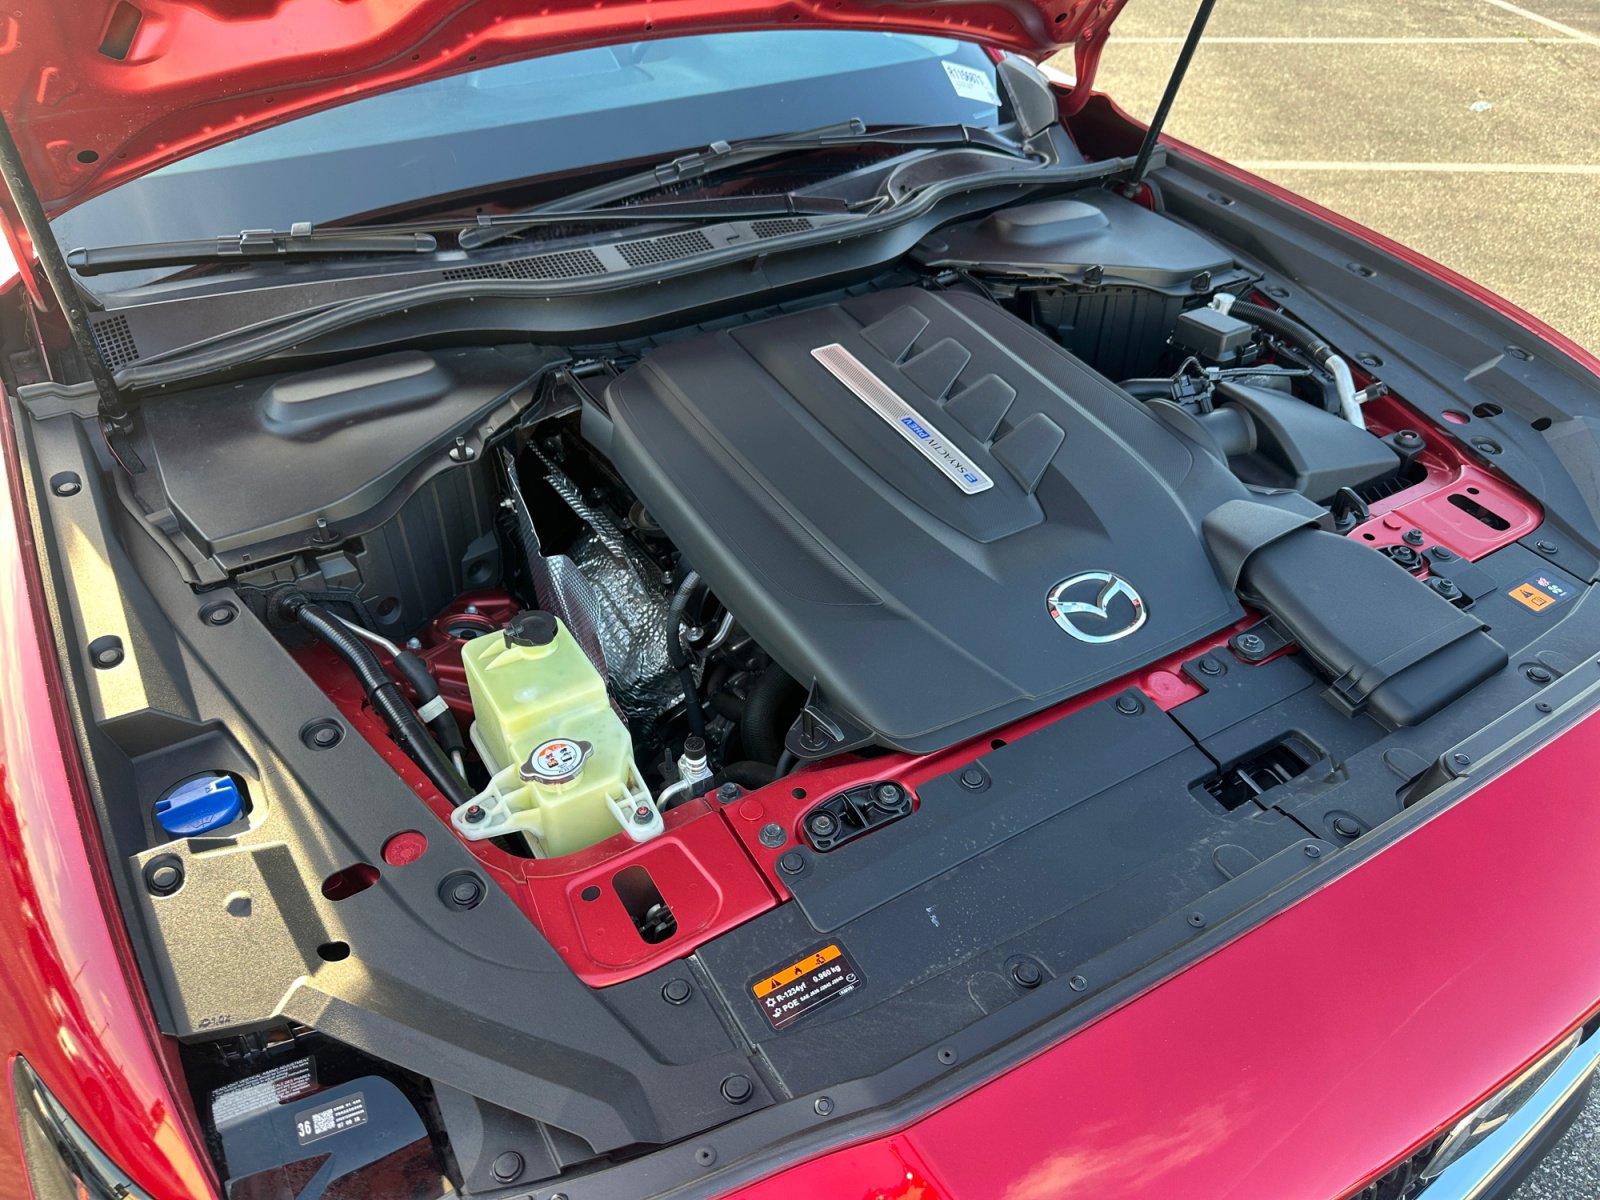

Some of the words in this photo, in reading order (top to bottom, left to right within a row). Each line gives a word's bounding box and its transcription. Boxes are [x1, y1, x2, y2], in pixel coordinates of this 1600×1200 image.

[903, 418, 929, 438] PHEV
[926, 438, 968, 474] SKYACTIV
[776, 982, 807, 1002] R-1234yf
[830, 965, 842, 973] kg
[782, 999, 800, 1012] POE
[279, 1057, 310, 1070] ADJUSTMENT
[297, 1120, 312, 1137] 36
